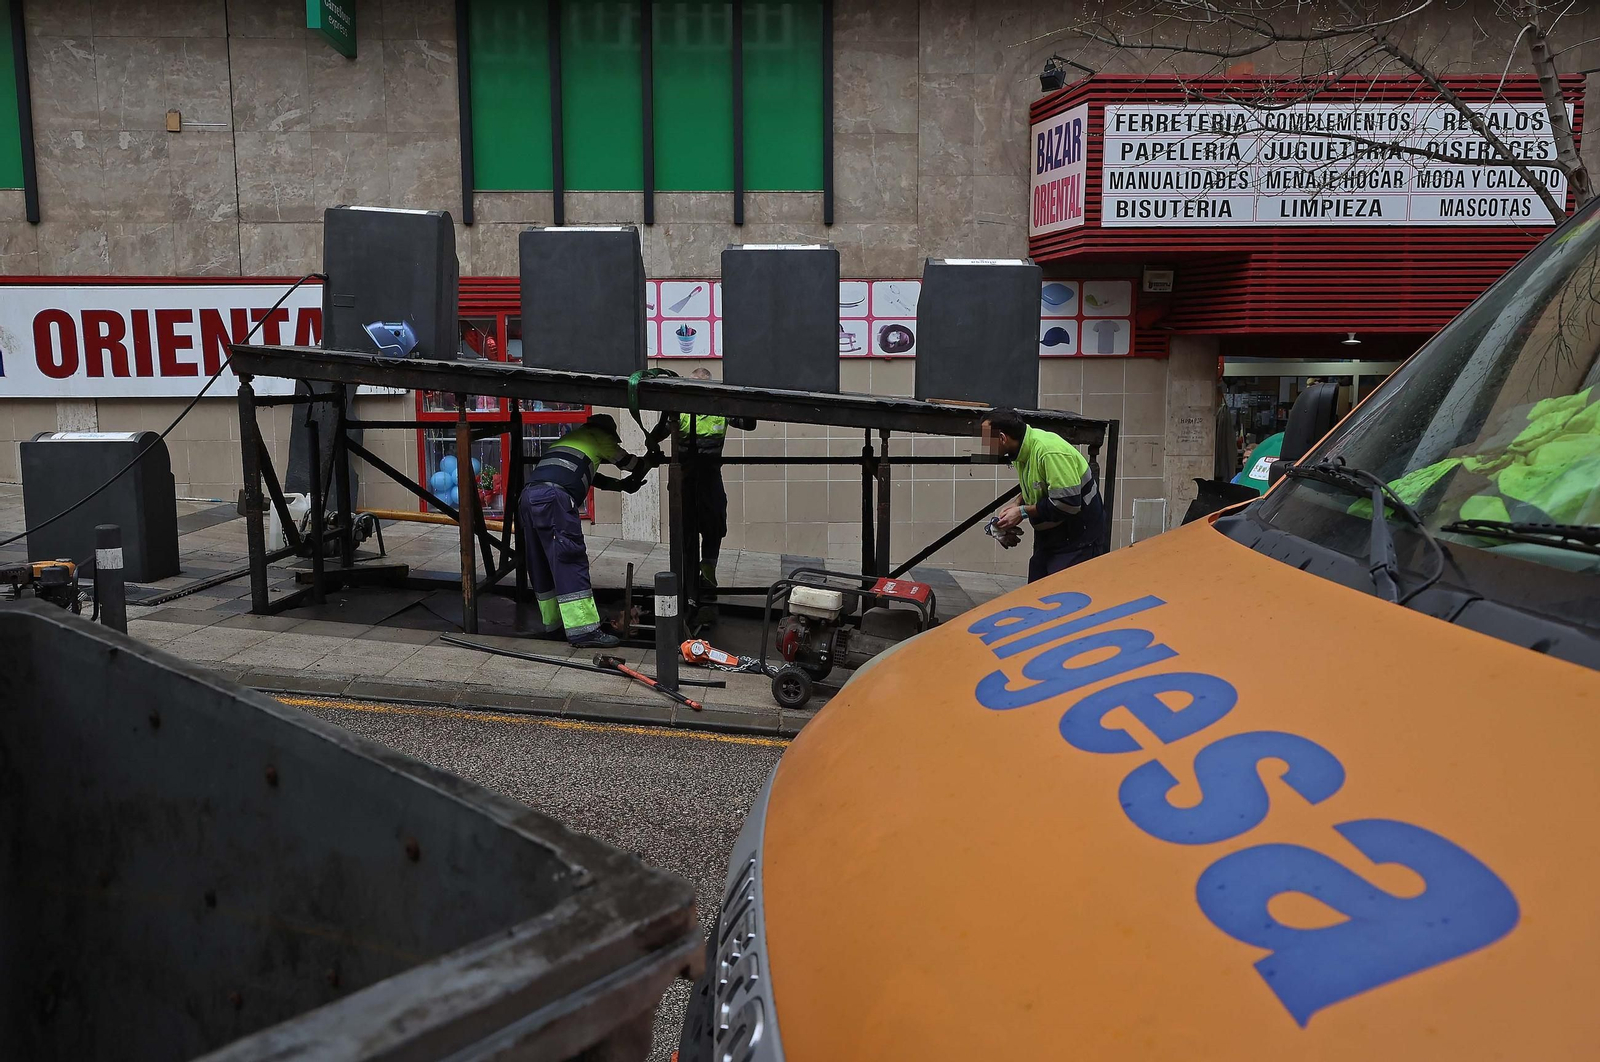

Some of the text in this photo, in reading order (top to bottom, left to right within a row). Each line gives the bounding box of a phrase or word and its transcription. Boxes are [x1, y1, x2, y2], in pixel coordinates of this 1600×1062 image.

[1115, 113, 1247, 132] FERRETERIA
[1265, 112, 1411, 132] COMPLEMENTOS
[1036, 117, 1082, 176] BAZAR
[1121, 142, 1241, 161] PAPELERIA
[1110, 171, 1249, 190] MANUALIDADES
[1343, 170, 1404, 189] HOGAR
[1416, 170, 1465, 189] MODA
[1471, 170, 1481, 188] Y
[1033, 172, 1082, 228] ORIENTAL
[1116, 199, 1232, 218] BISUTERIA
[1280, 199, 1383, 218] LIMPIEZA
[1439, 198, 1531, 217] MASCOTAS
[967, 591, 1521, 1030] algesa
